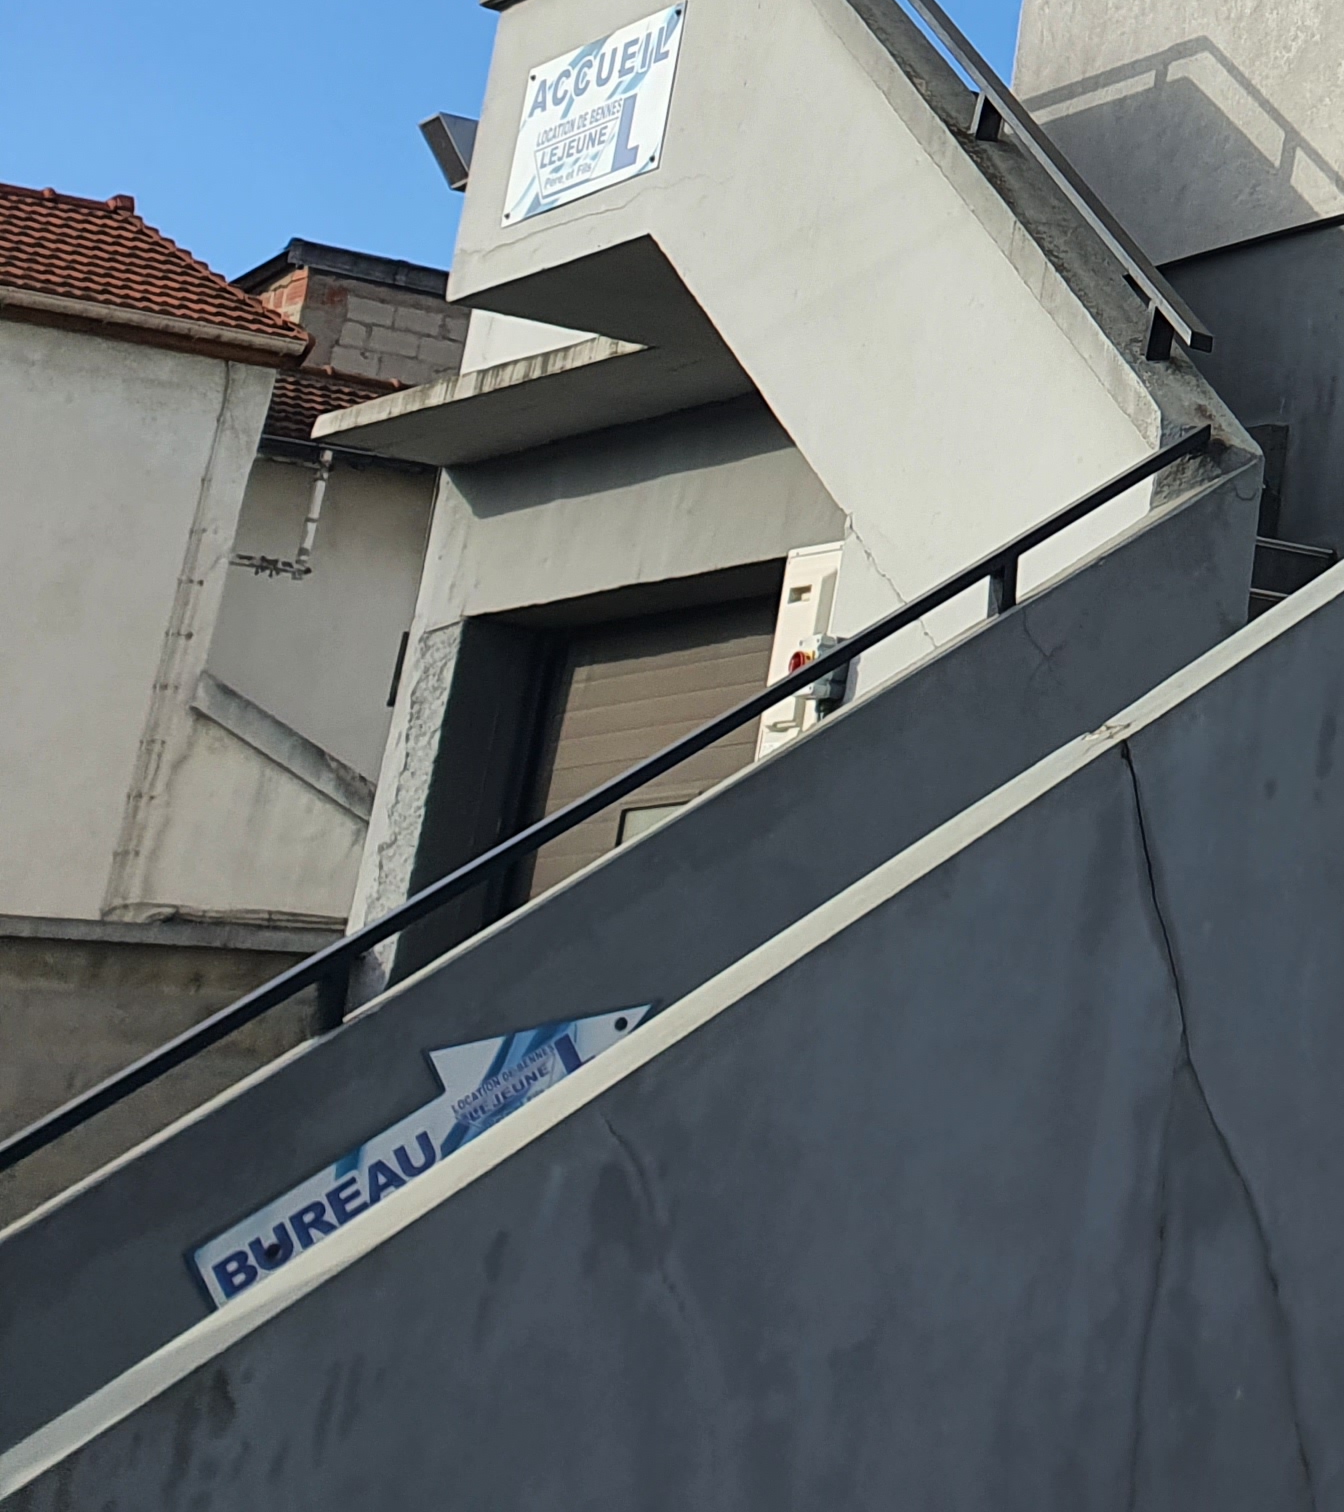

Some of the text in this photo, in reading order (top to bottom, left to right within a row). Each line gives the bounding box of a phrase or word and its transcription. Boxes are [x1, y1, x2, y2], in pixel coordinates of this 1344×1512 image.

[528, 25, 669, 119] ACCUEIL
[536, 96, 623, 147] LOCATION DE BENNES
[540, 125, 609, 169] LEJEUNE
[451, 1073, 501, 1115] LOCATION
[212, 1130, 438, 1299] BUREAU
